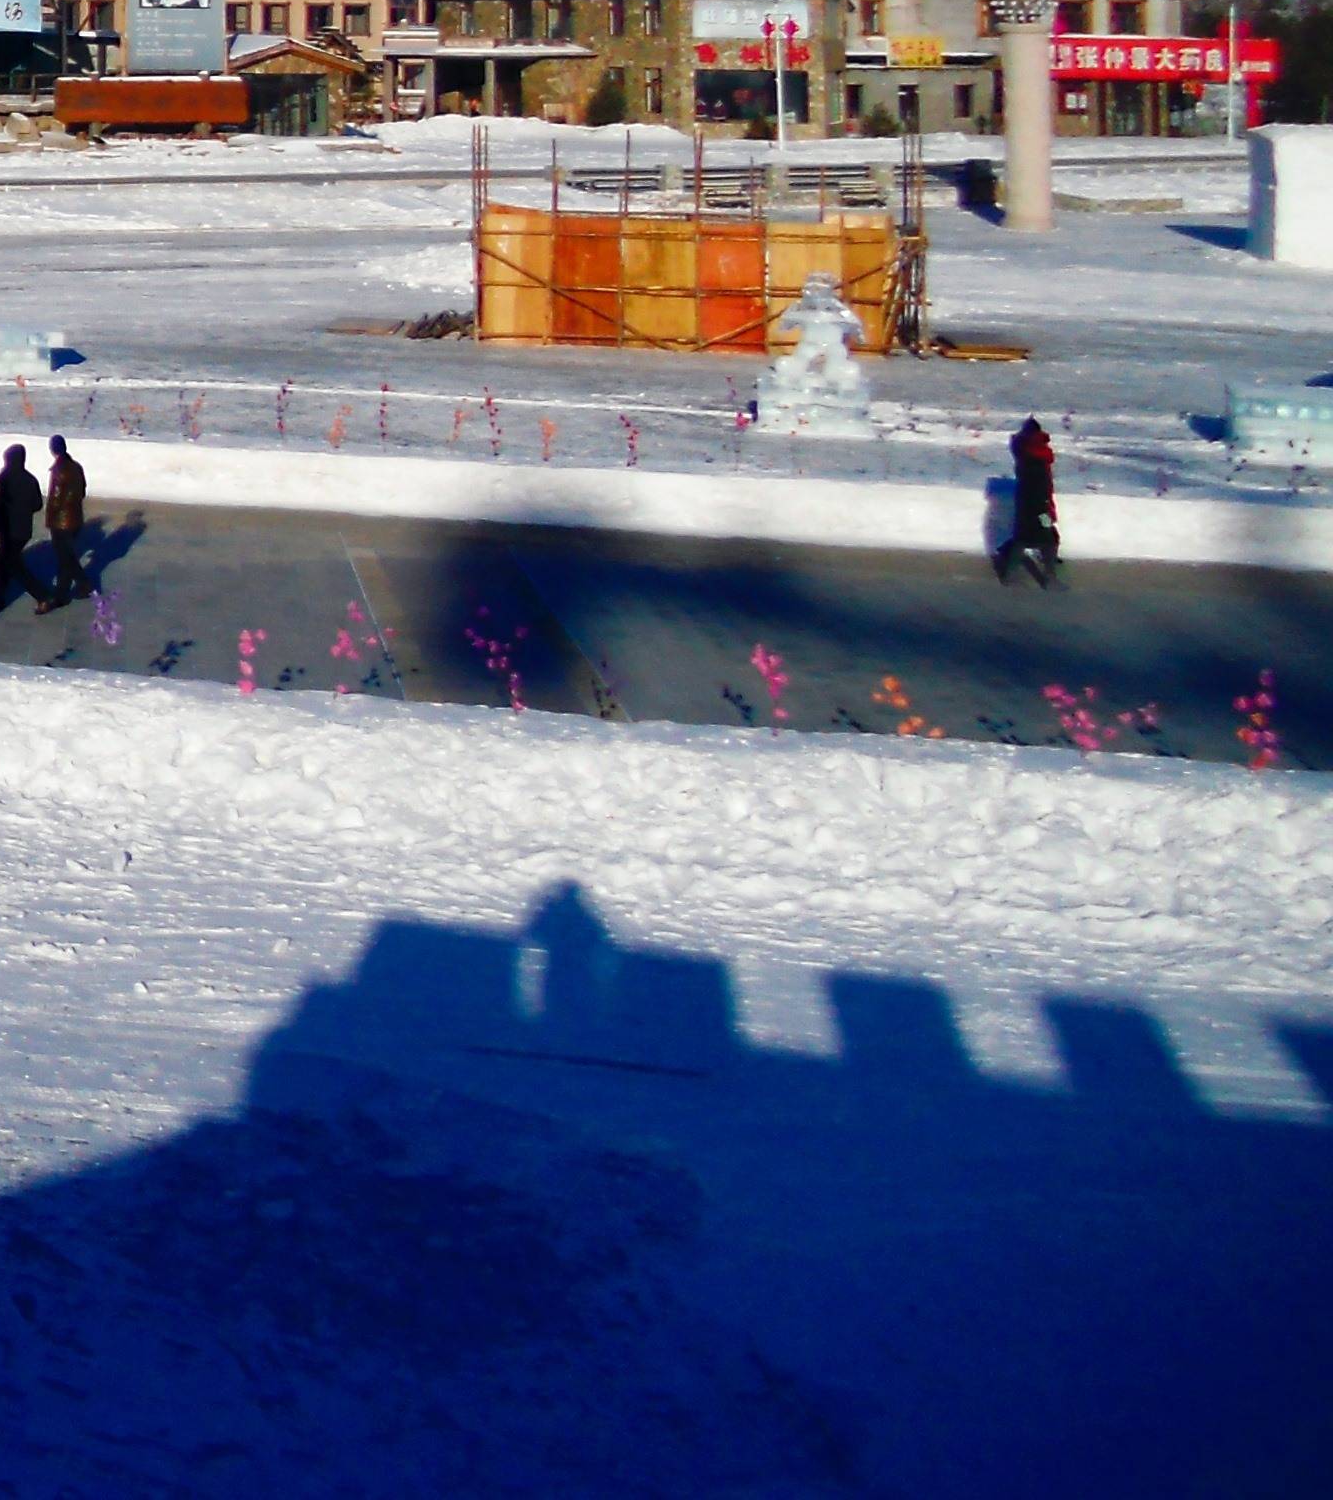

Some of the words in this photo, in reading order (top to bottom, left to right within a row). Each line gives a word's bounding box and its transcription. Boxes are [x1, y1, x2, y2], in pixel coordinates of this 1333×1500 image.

[1076, 45, 1223, 72] 张仲景大药房
